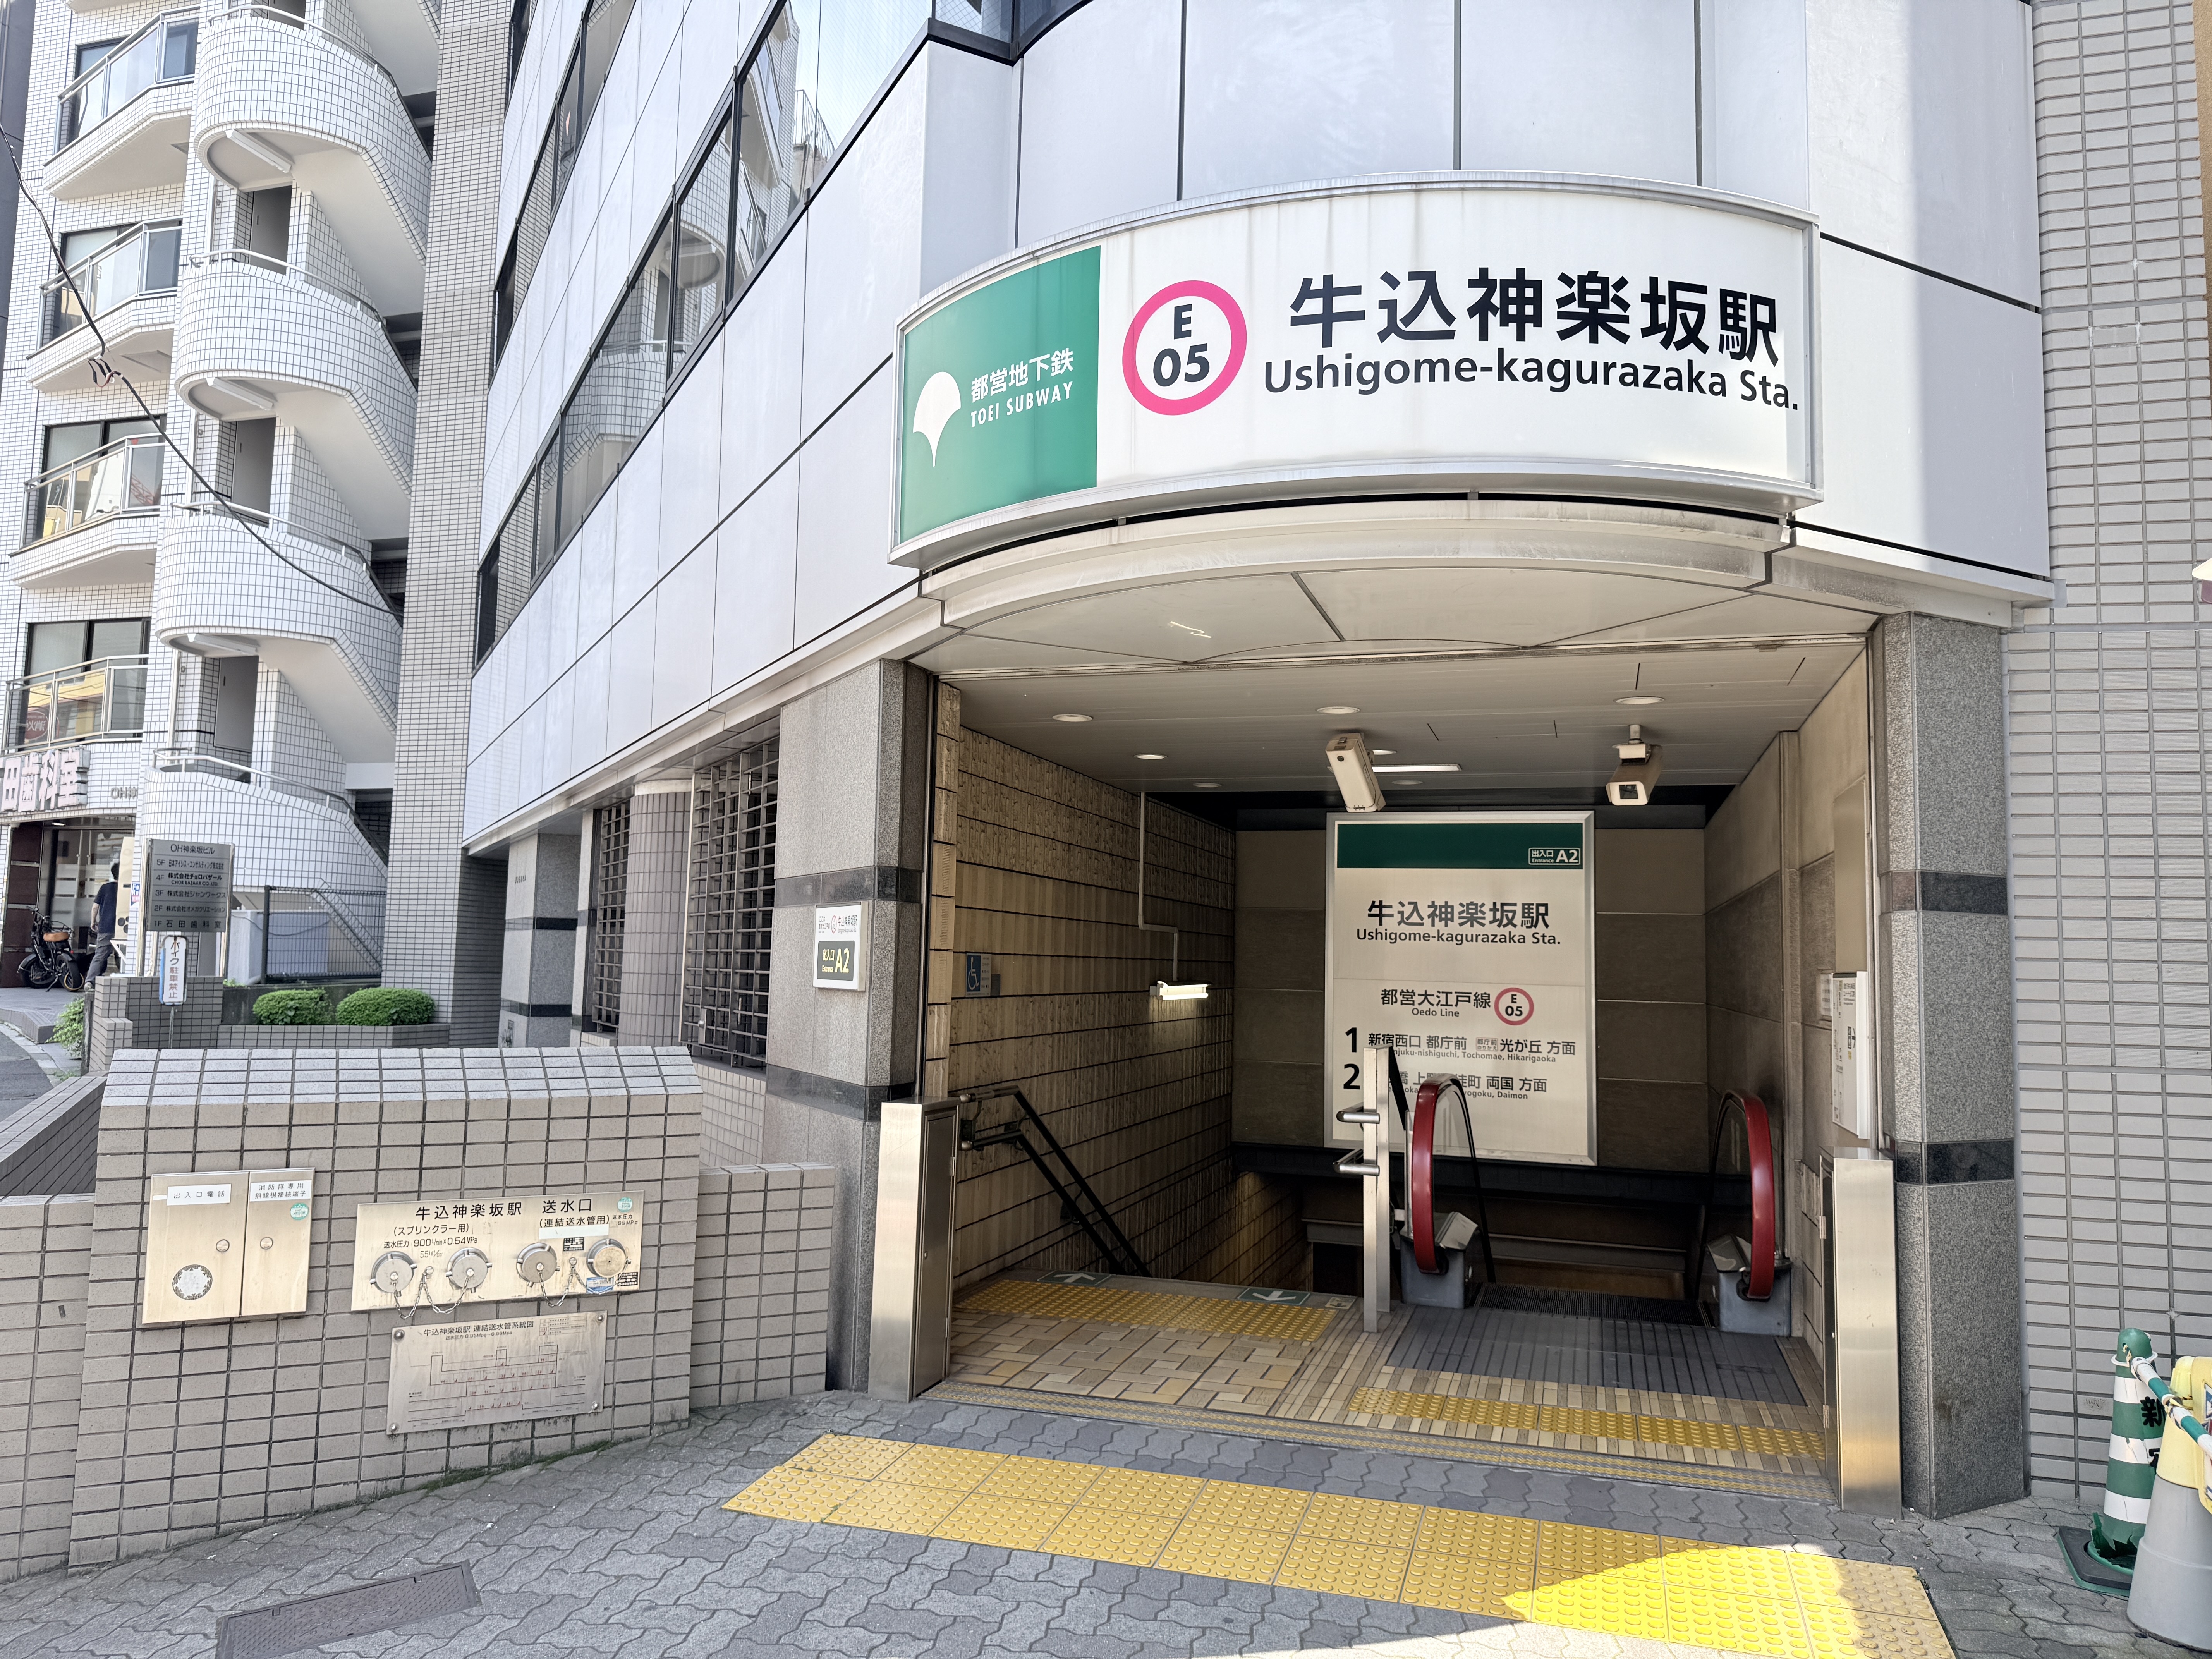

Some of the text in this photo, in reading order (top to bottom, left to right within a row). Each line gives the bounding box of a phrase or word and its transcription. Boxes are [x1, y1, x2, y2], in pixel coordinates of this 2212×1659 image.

[1174, 304, 1192, 339] E
[1290, 267, 1779, 368] 牛込神楽坂駅
[1154, 343, 1211, 388] 05
[971, 348, 1073, 404] 都営地下鉄
[1265, 348, 1797, 410] Ushigome-kagurazaka Sta.
[970, 380, 1073, 428] TOEI SUBWAY
[0, 747, 80, 812] 田歯科室
[170, 844, 215, 854] OH神楽坂ビル
[1556, 850, 1578, 863] A2
[1368, 900, 1549, 929] 牛込神楽坂駅
[166, 919, 222, 929] 石田歯科室
[1357, 928, 1560, 945] Ushigome-kagurazaka Sta.
[823, 948, 850, 973] 出入口 A2
[168, 942, 180, 999] バイク駐車禁止
[1381, 988, 1491, 1008] 都営大江戸線
[1511, 994, 1516, 1003] E
[1441, 1008, 1459, 1017] Line
[1505, 1006, 1523, 1017] 05
[1346, 1027, 1467, 1052] 1 新宿西口 都庁前
[1500, 1038, 1576, 1055] 光が丘 方面
[1394, 1048, 1556, 1063] njuku-nishiguchi, Tochomae, Hikarigaoka
[1343, 1064, 1360, 1089] 2
[1413, 1072, 1481, 1089] 上徒町
[1486, 1075, 1514, 1091] 両国
[1519, 1077, 1547, 1092] 方面
[1465, 1090, 1494, 1098] ogoku,
[173, 1190, 225, 1199] 出入口電話
[415, 1197, 593, 1220] 牛込神楽坂駅 送水口
[393, 1223, 470, 1237] (スプリンクラー用)
[539, 1215, 610, 1228] (連結送水管用)
[383, 1240, 409, 1249] 送水圧力
[424, 1325, 471, 1336] 牛込神楽坂駅
[473, 1320, 534, 1332] 連結送水管系統図
